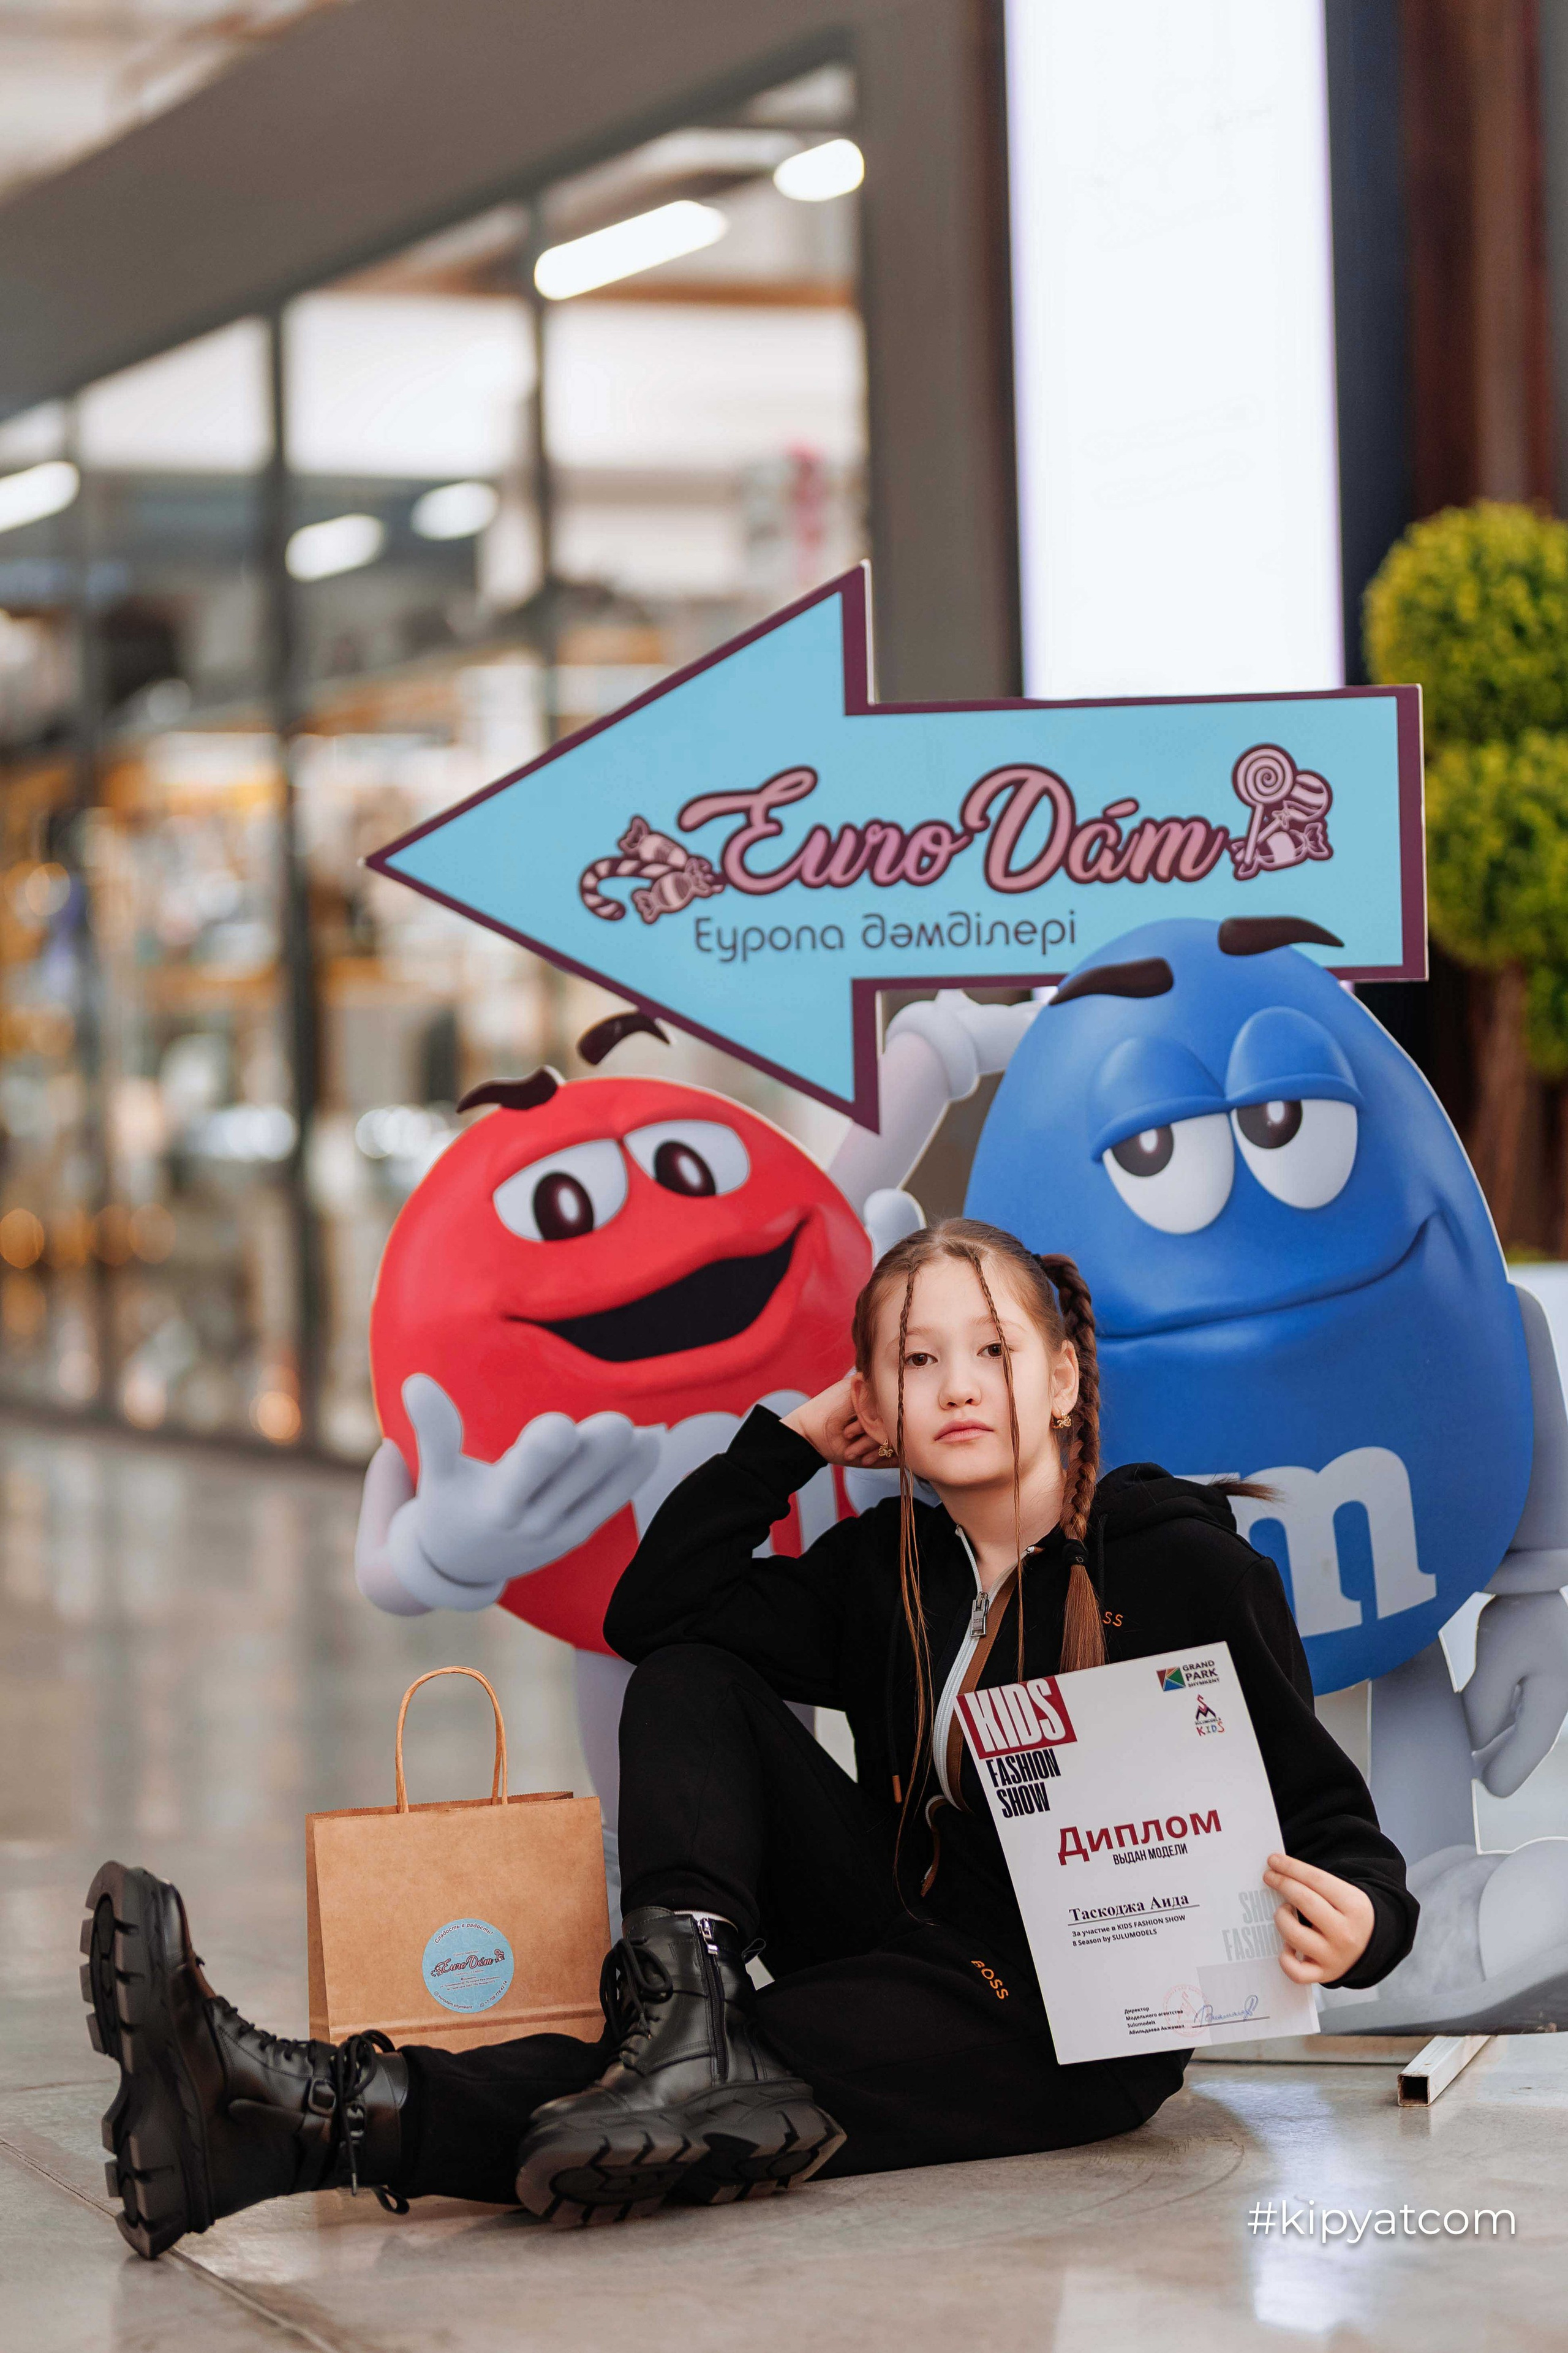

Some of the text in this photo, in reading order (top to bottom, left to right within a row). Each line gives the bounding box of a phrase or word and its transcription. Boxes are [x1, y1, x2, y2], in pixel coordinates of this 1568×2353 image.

[694, 910, 1076, 962] Еуропа дәмділері
[1182, 1660, 1215, 1671] GRAND
[1185, 1667, 1218, 1682] PARK
[1188, 1677, 1220, 1687] SHYMKENT
[964, 1677, 1066, 1753] KIDS
[1196, 1721, 1225, 1736] KIDS
[986, 1748, 1061, 1788] FASHION
[996, 1781, 1050, 1818] SHOW
[1057, 1810, 1222, 1866] Диплом
[1112, 1843, 1188, 1865] ВЫДАН МОДЕЛИ
[1068, 1895, 1189, 1922] Таскоджа Аида
[1082, 1927, 1110, 1937] участие
[1117, 1922, 1133, 1930] KIDS
[1133, 1918, 1164, 1928] FASHION
[1165, 1914, 1186, 1924] SHOW
[1078, 1937, 1101, 1946] Season
[1112, 1928, 1158, 1941] SULUMODELS
[1124, 2006, 1150, 2015] Директор
